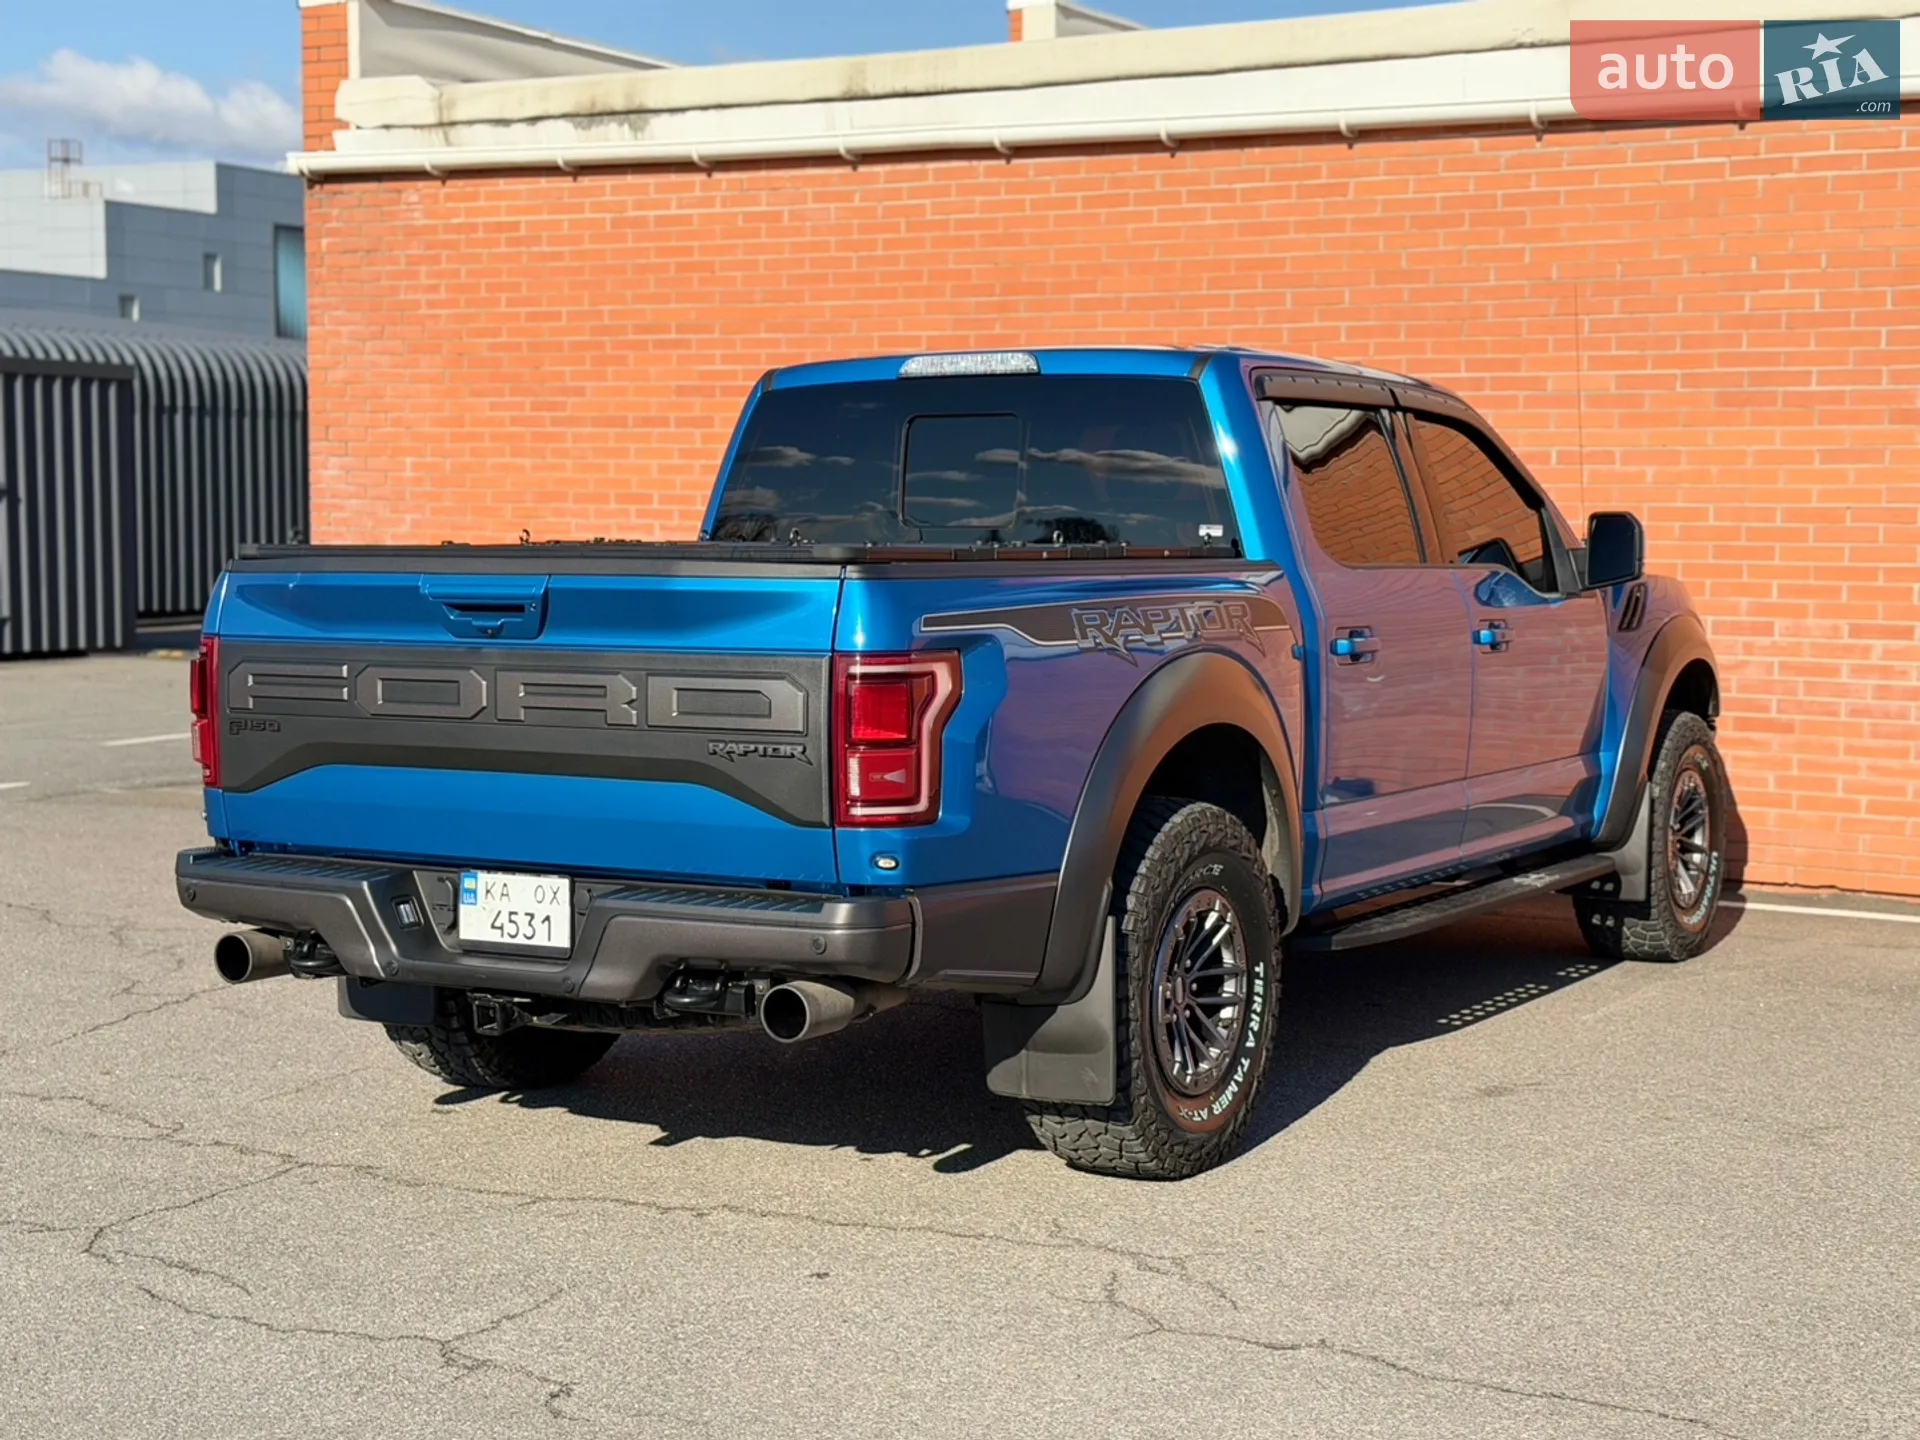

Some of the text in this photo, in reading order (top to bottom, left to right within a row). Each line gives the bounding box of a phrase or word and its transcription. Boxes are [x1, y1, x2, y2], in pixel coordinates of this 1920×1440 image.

[1070, 601, 1266, 668] RAPTOR
[227, 659, 807, 734] FORD
[707, 740, 813, 766] RAPTOR
[462, 891, 477, 905] UA
[484, 881, 560, 905] KA OX
[490, 909, 551, 942] 4531
[1245, 961, 1264, 1048] TERRA
[1211, 1057, 1251, 1115] TAMER
